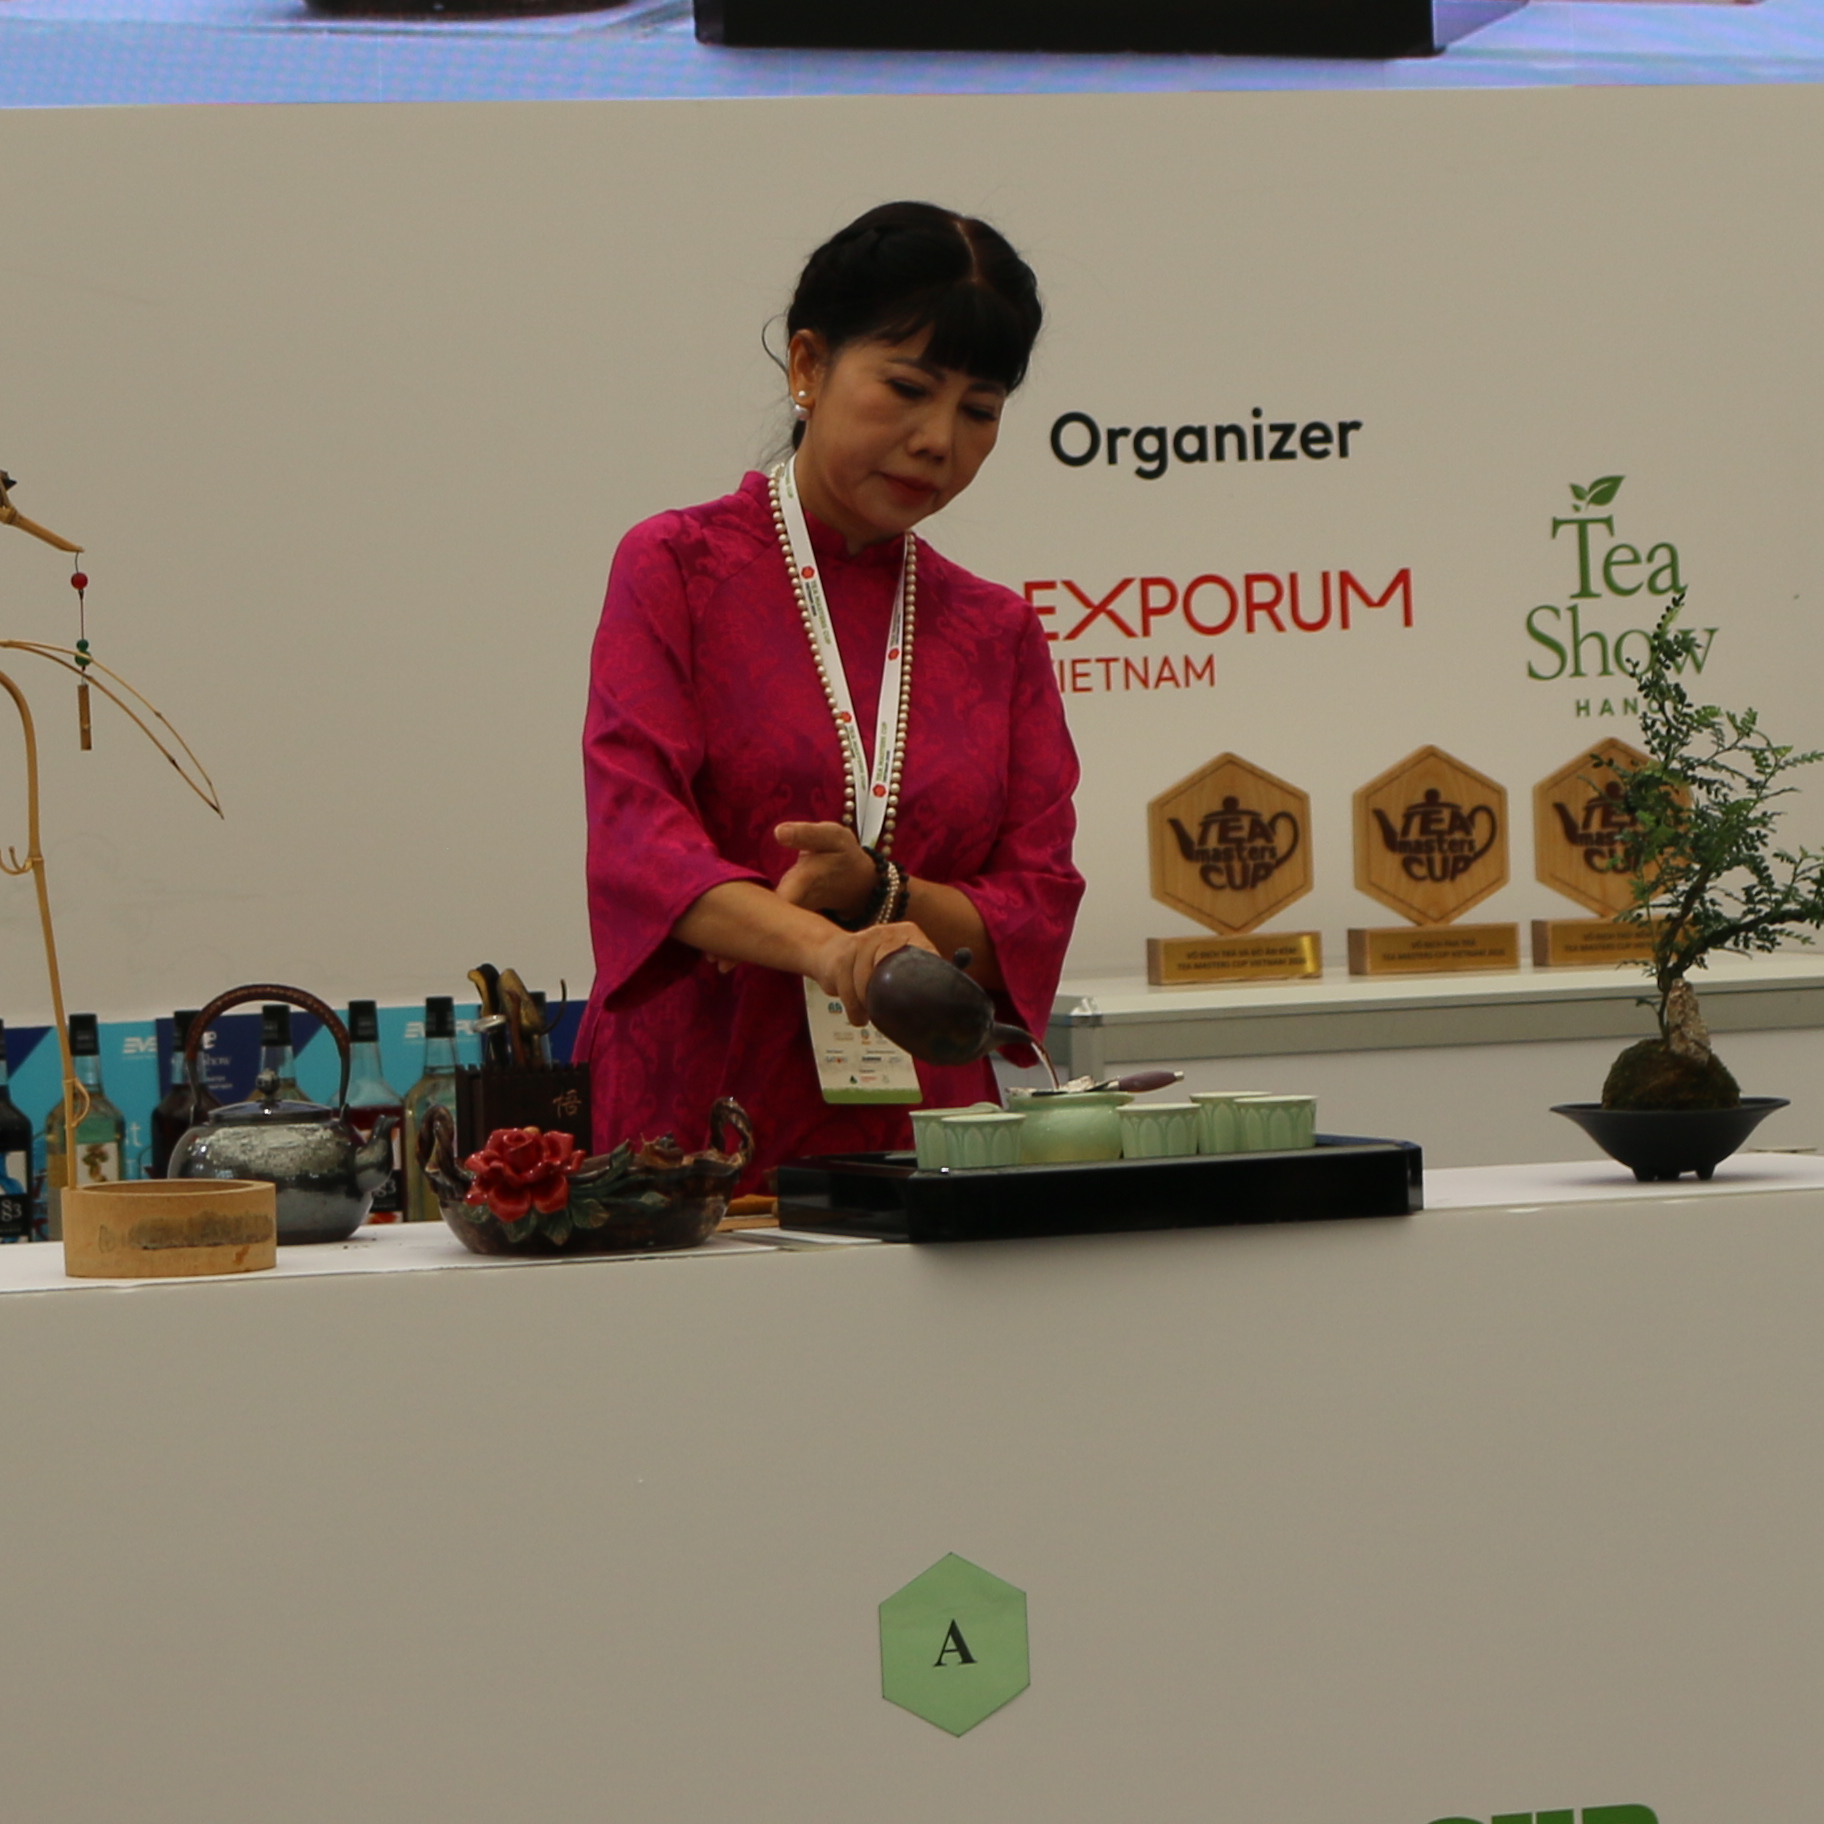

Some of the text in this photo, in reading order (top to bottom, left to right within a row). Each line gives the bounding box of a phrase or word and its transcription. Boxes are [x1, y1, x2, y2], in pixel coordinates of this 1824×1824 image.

[1050, 408, 1362, 480] Organizer
[1551, 514, 1688, 599] Tea
[1023, 567, 1414, 642] EXPORUM
[1054, 653, 1216, 694] IETNAM
[1199, 816, 1274, 846] TEA
[1402, 808, 1473, 836] TEA
[1199, 860, 1276, 891] CUP
[1402, 854, 1474, 882] CUP
[933, 1618, 978, 1668] A
